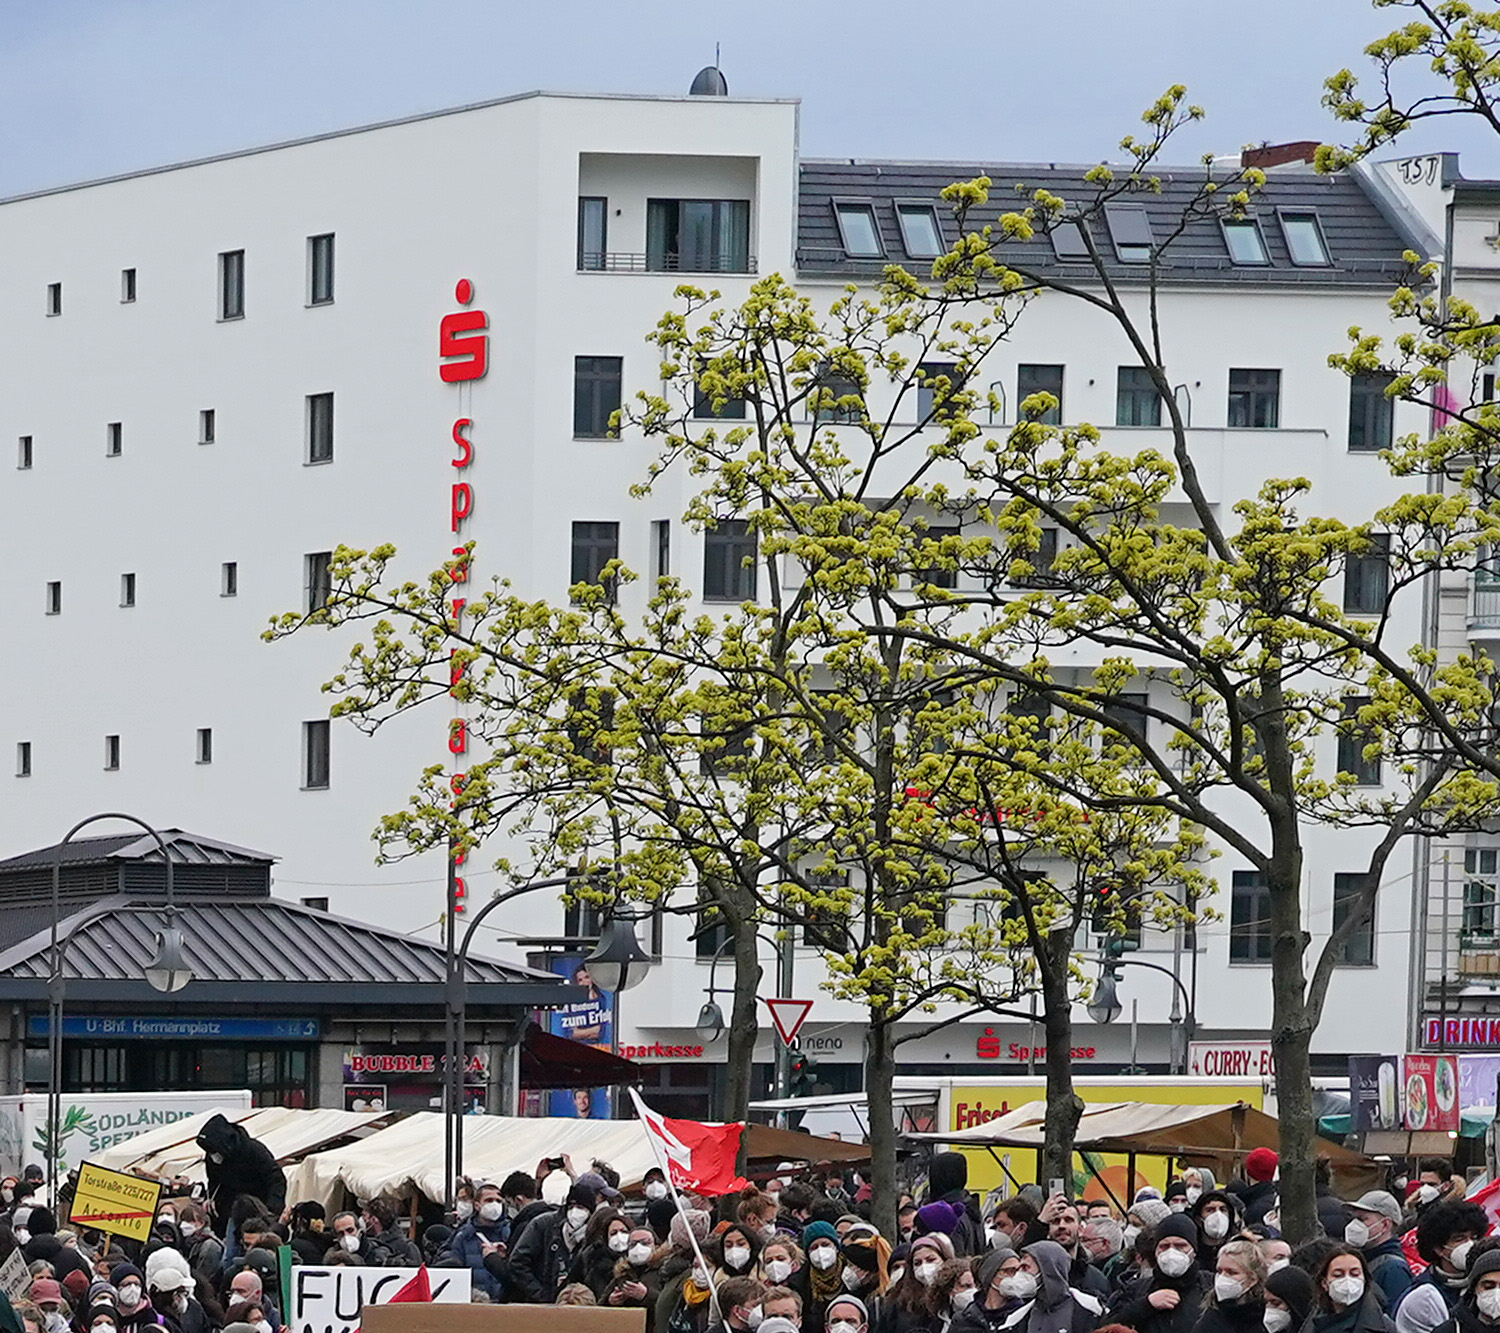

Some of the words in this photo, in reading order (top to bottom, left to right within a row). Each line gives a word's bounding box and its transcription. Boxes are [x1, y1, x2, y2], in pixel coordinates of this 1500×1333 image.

[132, 1020, 221, 1036] Hermannplatz
[561, 1012, 587, 1028] zum
[1008, 1043, 1096, 1059] Sparsse
[351, 1054, 436, 1073] BUBBLE
[1204, 1050, 1252, 1075] CURRY
